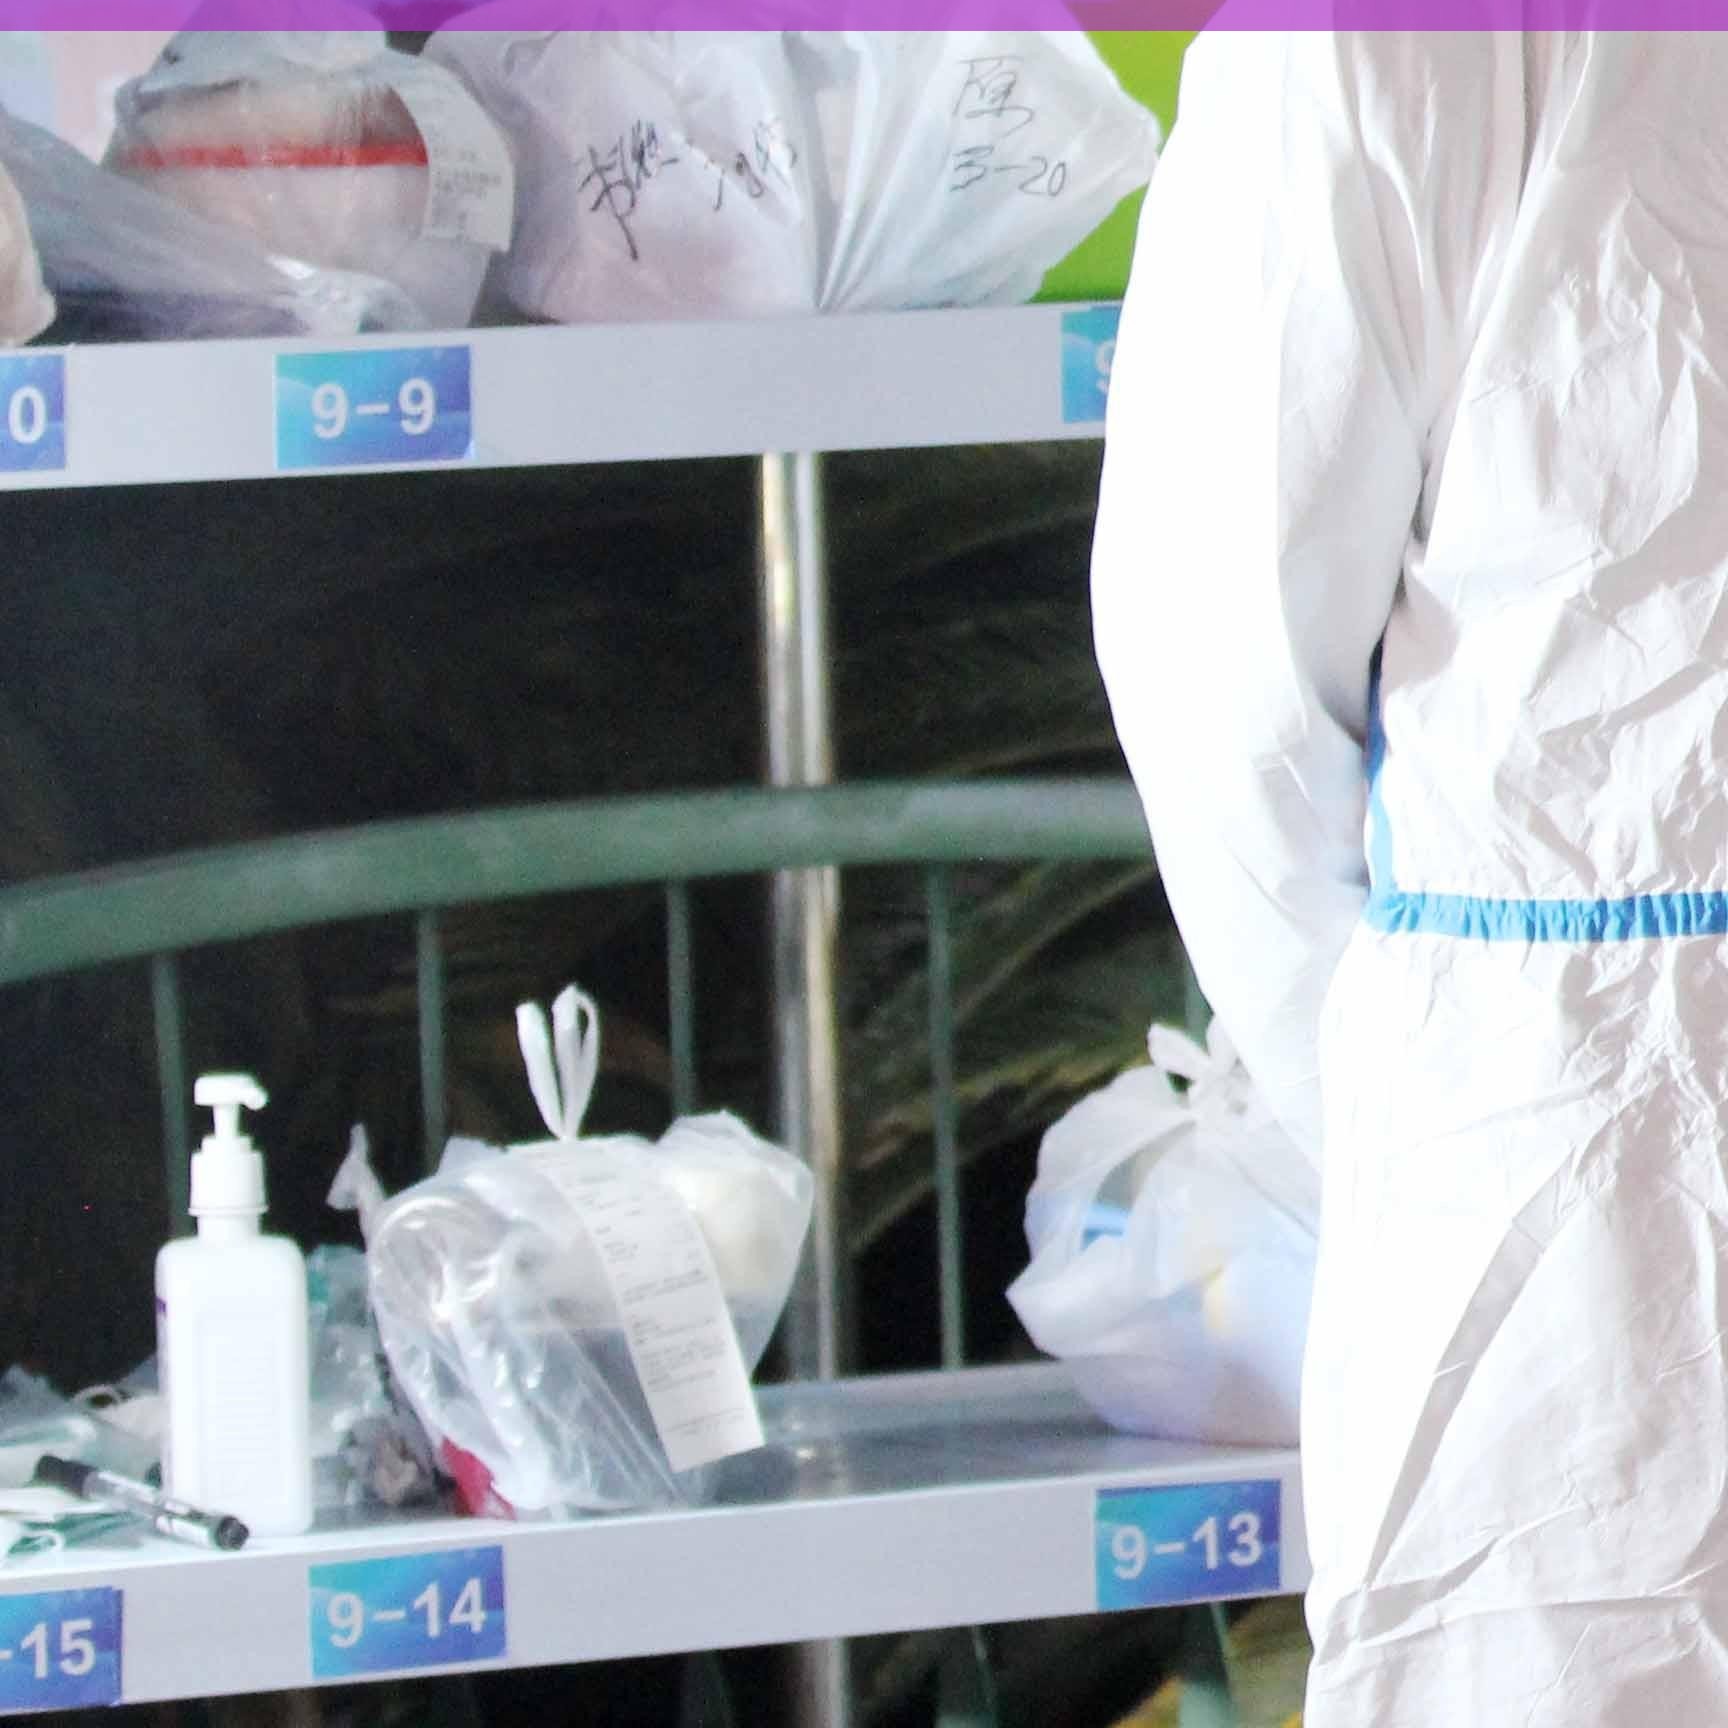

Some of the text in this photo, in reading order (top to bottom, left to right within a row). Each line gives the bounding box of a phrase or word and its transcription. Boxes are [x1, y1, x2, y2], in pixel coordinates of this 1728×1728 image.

[312, 378, 437, 439] 9-9
[1111, 1512, 1263, 1581] 9-13
[327, 1577, 487, 1649] 9-14
